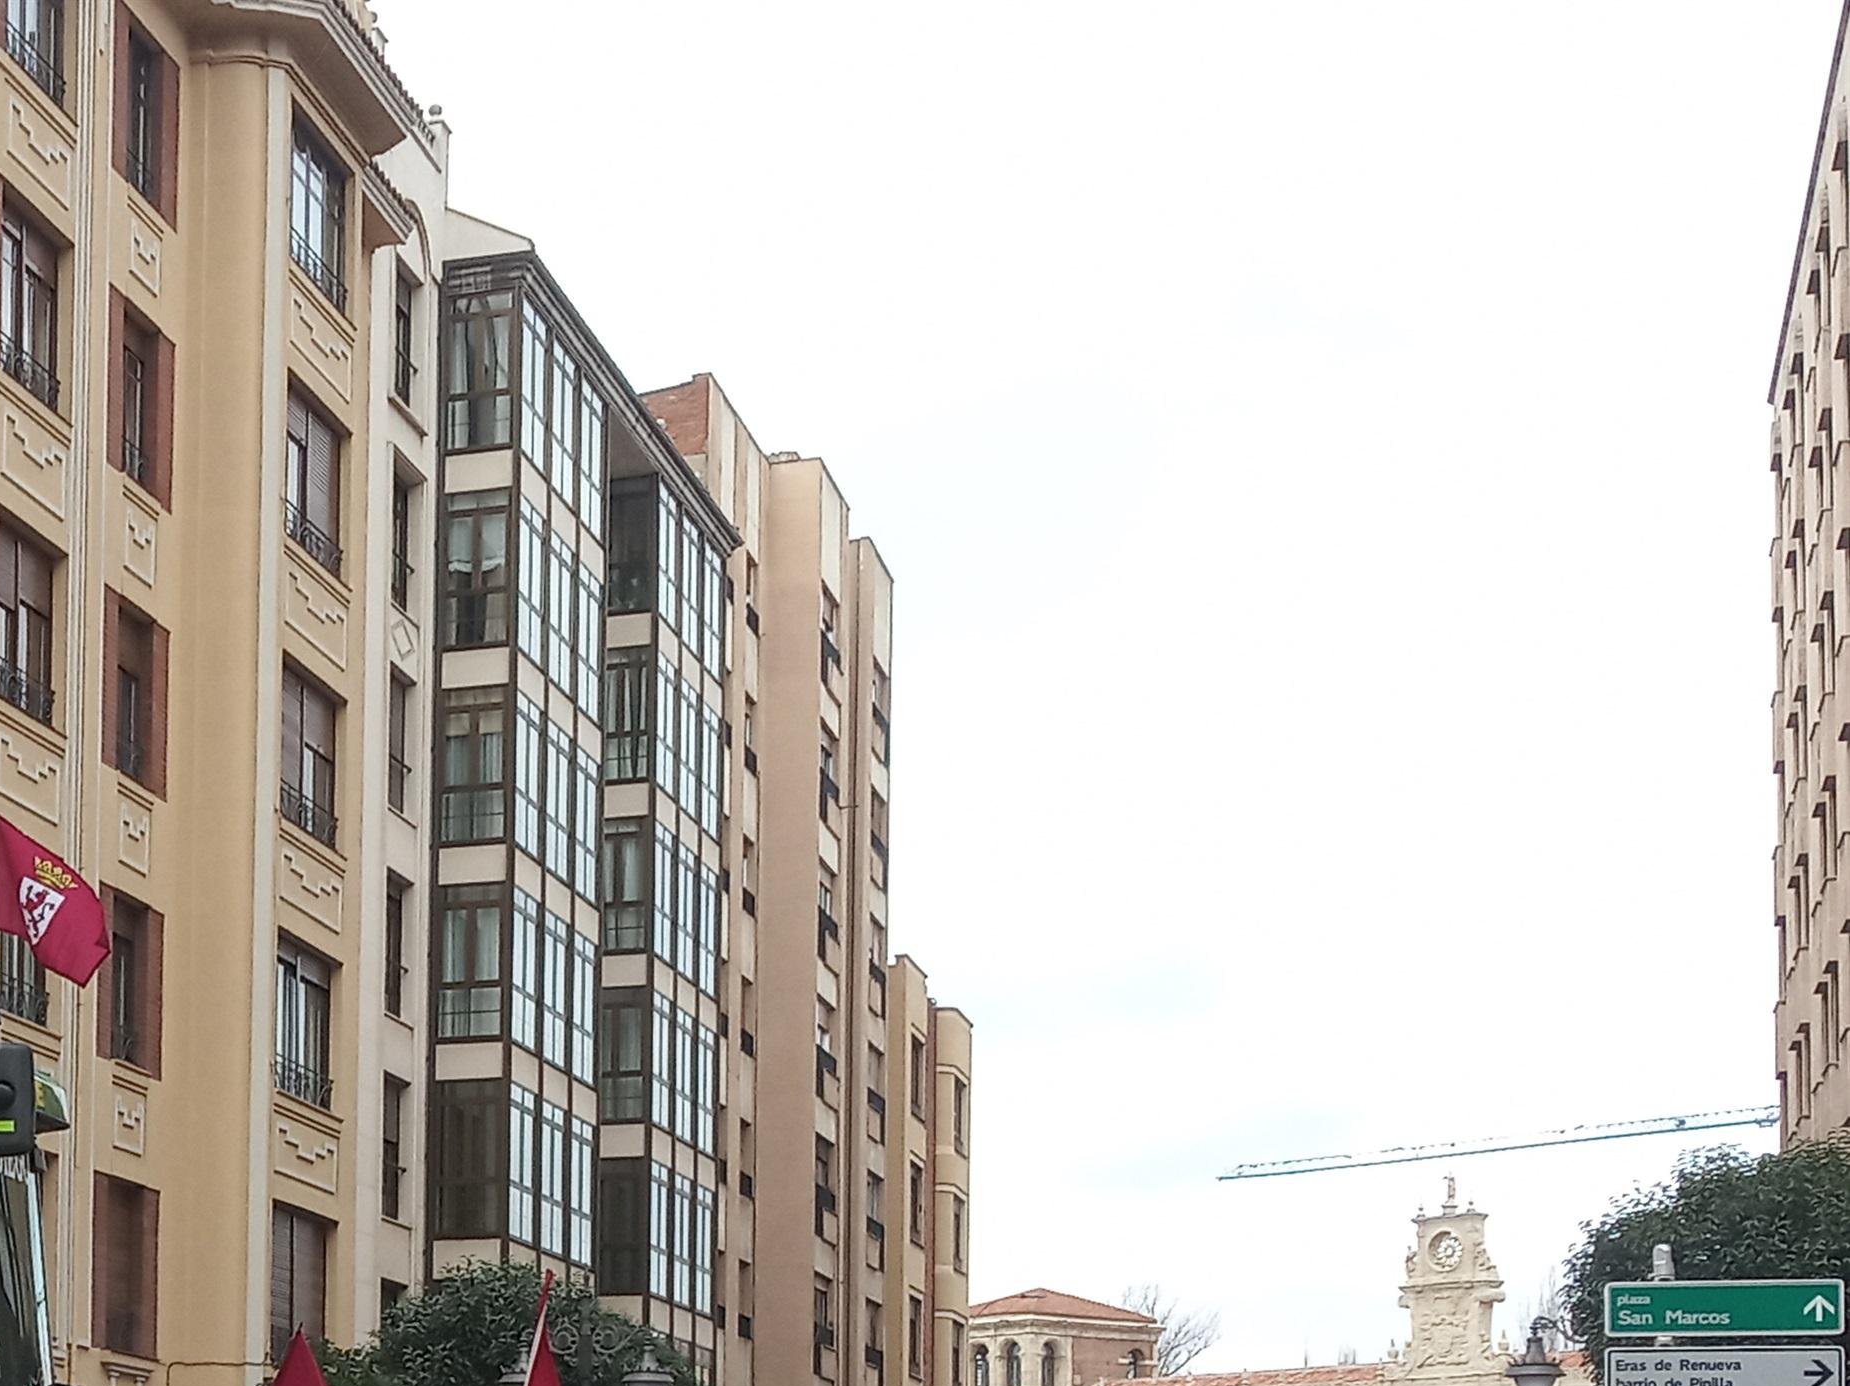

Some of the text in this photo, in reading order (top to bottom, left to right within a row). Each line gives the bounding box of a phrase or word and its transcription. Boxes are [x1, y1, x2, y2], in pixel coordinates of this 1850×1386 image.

[1616, 1294, 1651, 1307] plaza
[1618, 1310, 1731, 1325] San Marcos
[1615, 1359, 1742, 1372] Eras de Renueva
